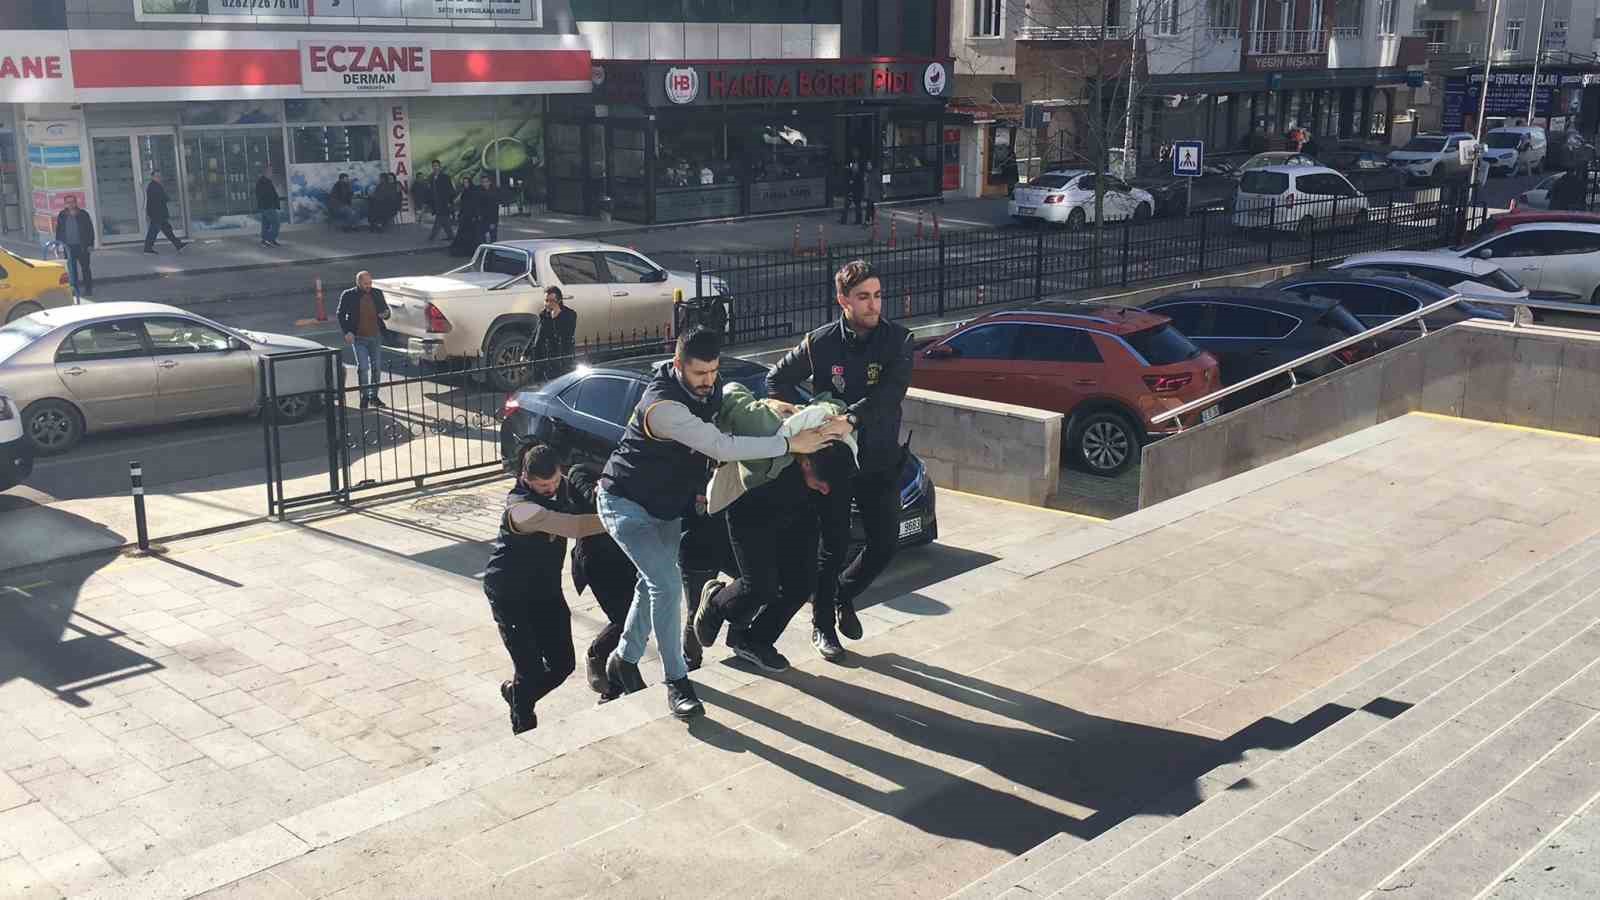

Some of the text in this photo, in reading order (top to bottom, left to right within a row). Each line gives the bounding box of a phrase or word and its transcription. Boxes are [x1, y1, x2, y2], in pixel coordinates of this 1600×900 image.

[309, 45, 424, 72] ECZANE
[343, 73, 396, 84] DERMAN
[673, 75, 690, 90] HB
[392, 106, 409, 212] ECZANE
